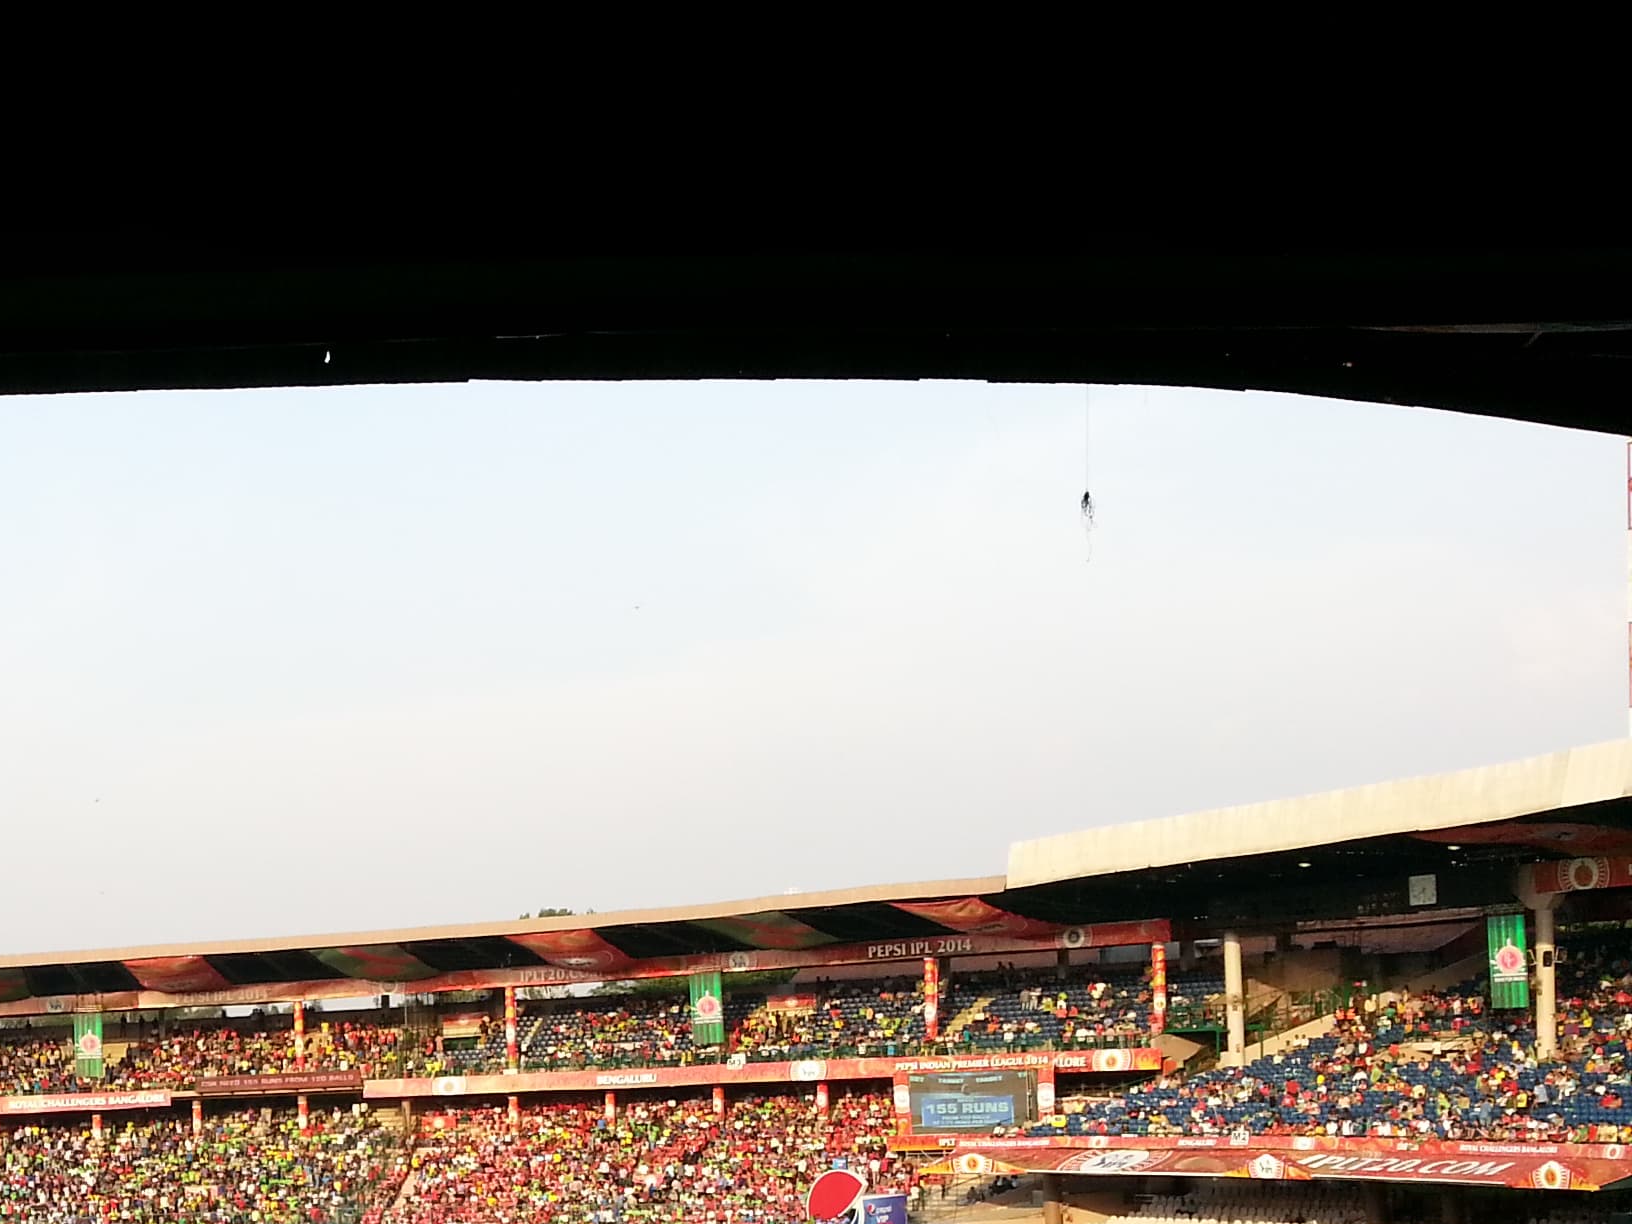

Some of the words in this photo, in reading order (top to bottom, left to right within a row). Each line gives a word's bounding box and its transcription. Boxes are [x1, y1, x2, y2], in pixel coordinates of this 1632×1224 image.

[868, 943, 906, 958] PEPSI
[910, 941, 933, 955] IPL
[937, 938, 972, 953] 2014
[920, 1060, 951, 1070] INDIAN
[952, 1058, 989, 1069] PREMIER
[1025, 1054, 1049, 1066] 2014
[596, 1073, 657, 1085] BENGALURU
[926, 1103, 958, 1114] 155
[962, 1101, 1009, 1113] RUNS
[1298, 1153, 1515, 1176] IPLT20.COM
